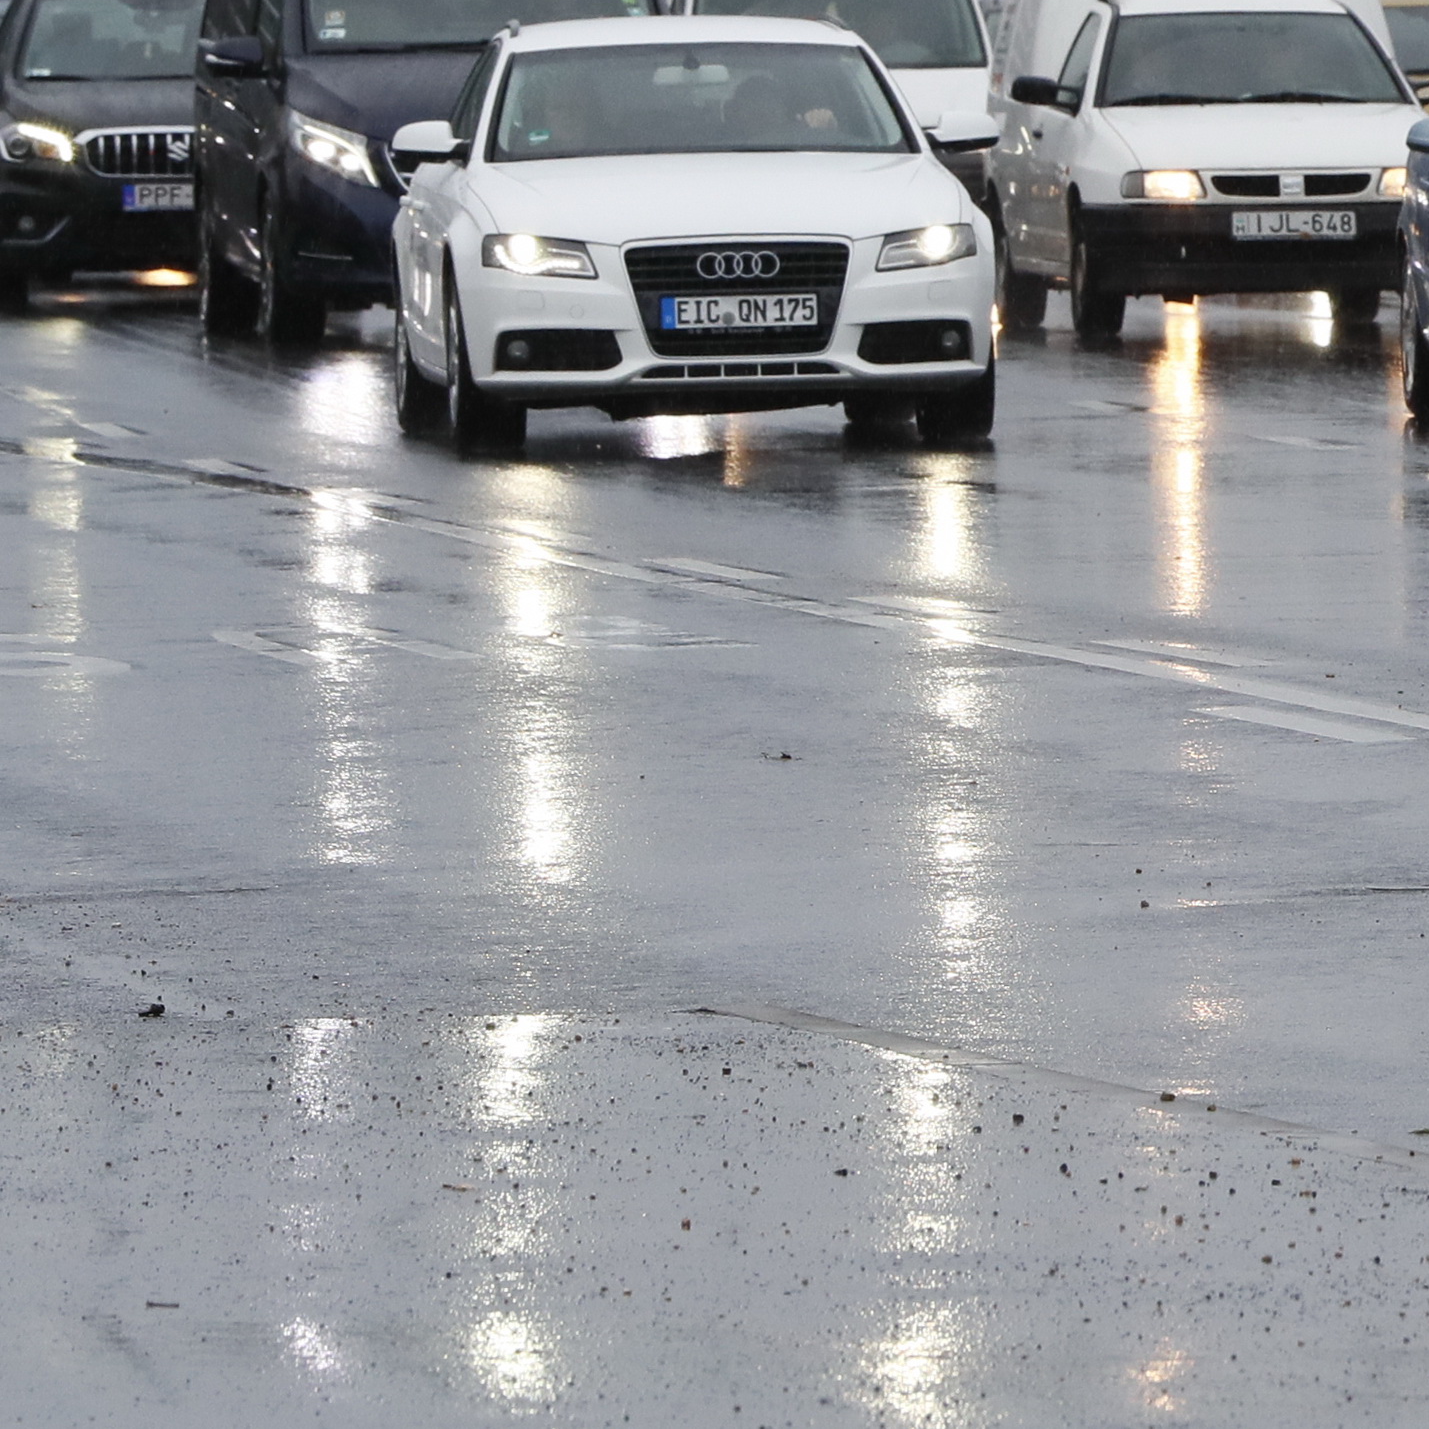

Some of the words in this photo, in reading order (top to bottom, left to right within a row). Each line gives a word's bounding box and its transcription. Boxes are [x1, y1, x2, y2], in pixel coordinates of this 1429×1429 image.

[139, 185, 192, 206] PPF-
[1257, 213, 1352, 233] IJL-648
[676, 300, 720, 324] EIC
[738, 298, 768, 323] QN
[773, 297, 815, 322] 175
